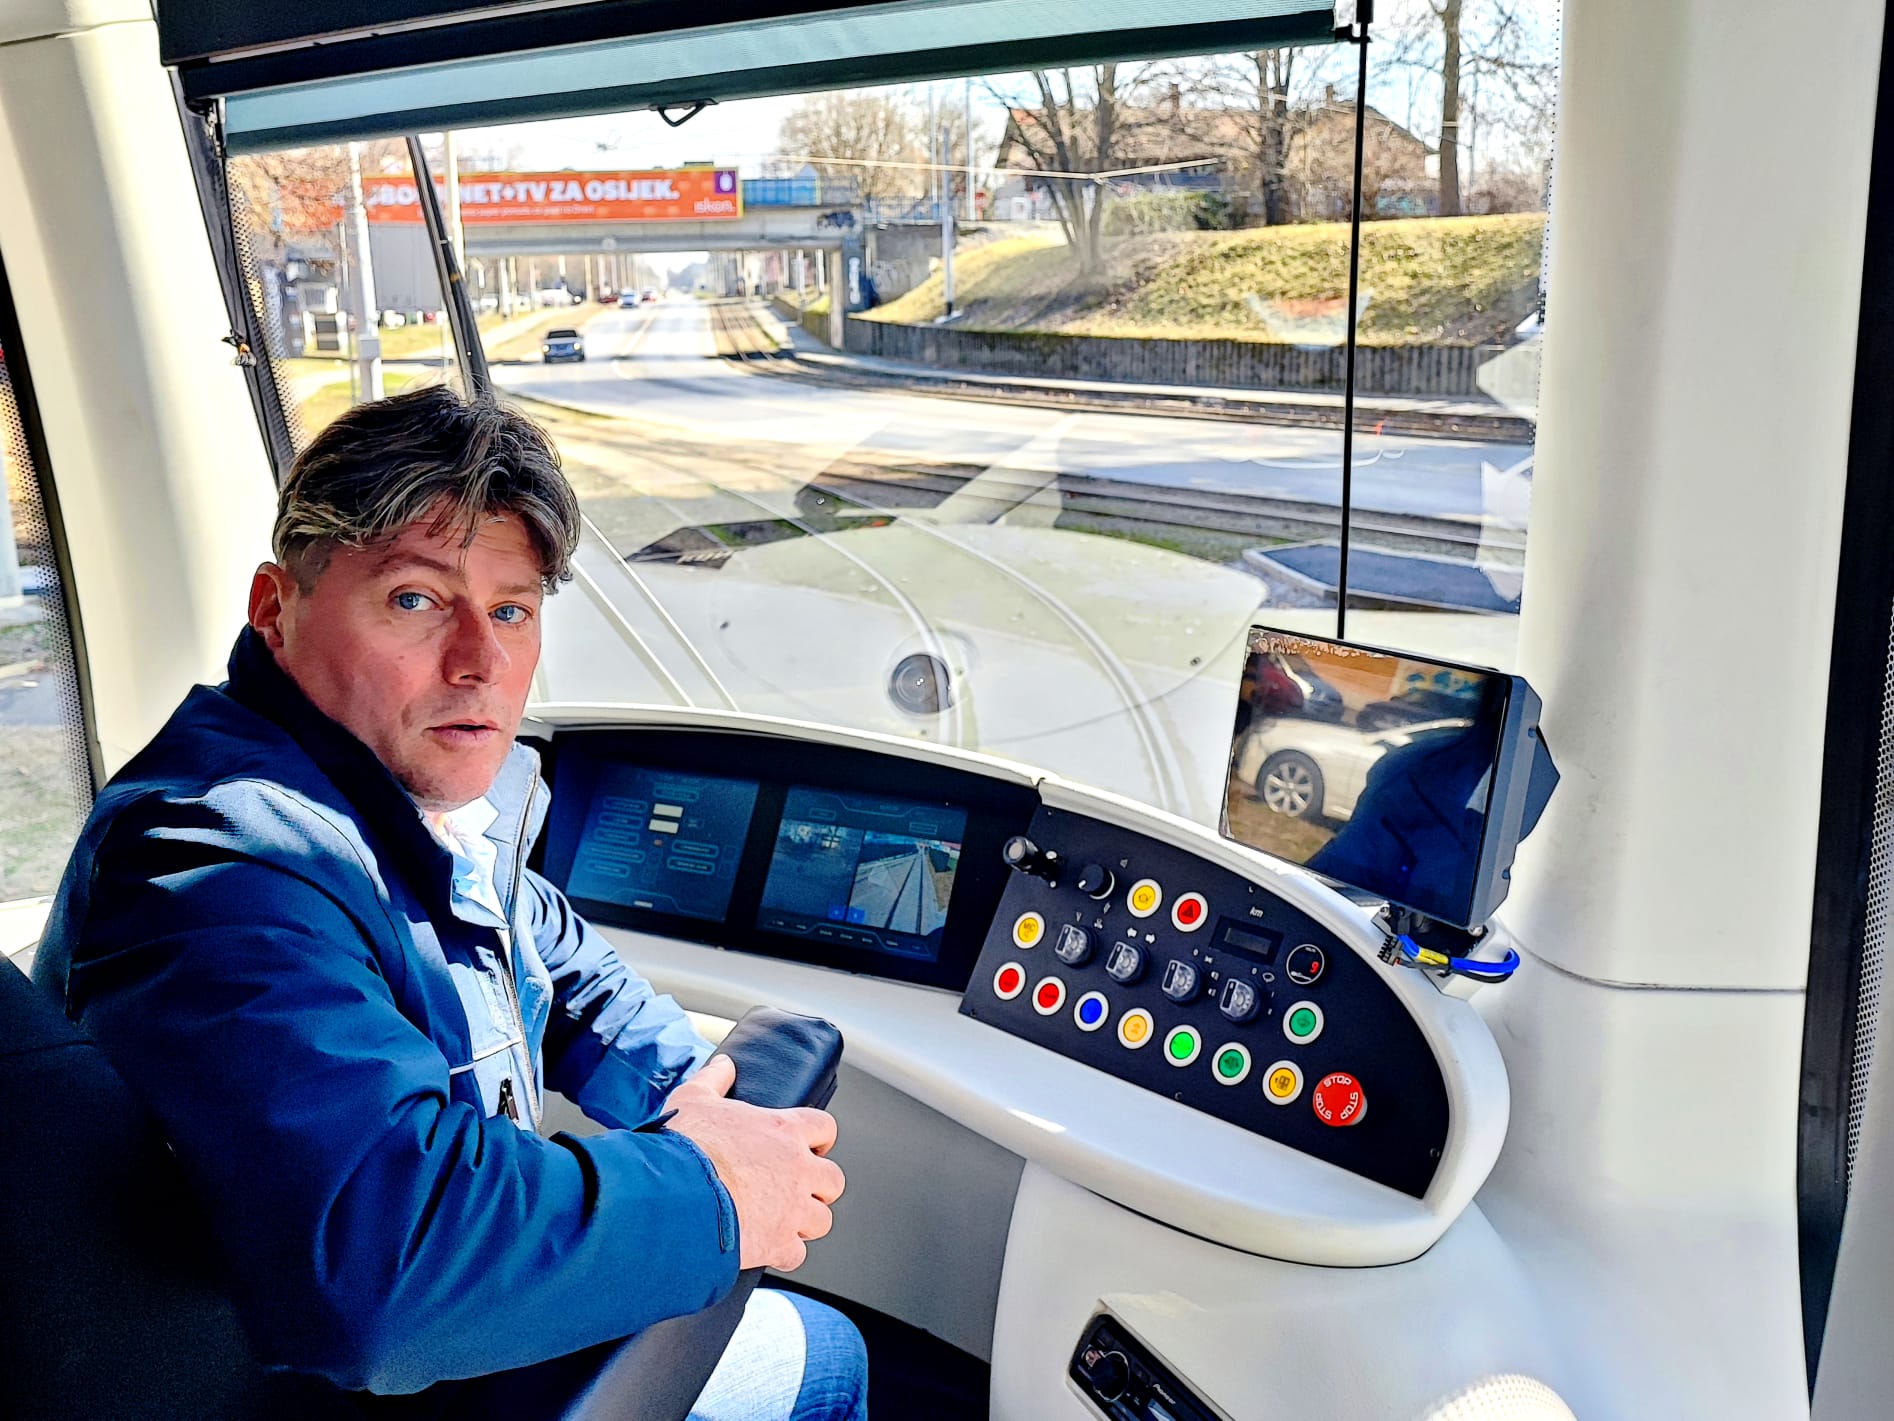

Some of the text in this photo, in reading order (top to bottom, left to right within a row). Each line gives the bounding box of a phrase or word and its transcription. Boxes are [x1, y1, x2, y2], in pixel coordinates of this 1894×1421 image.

[549, 180, 584, 202] ZA
[584, 178, 680, 201] OSIJEK.
[1249, 906, 1264, 918] km
[1323, 1075, 1352, 1088] STOP
[1315, 1092, 1332, 1120] STOP
[1340, 1091, 1359, 1120] STOP
